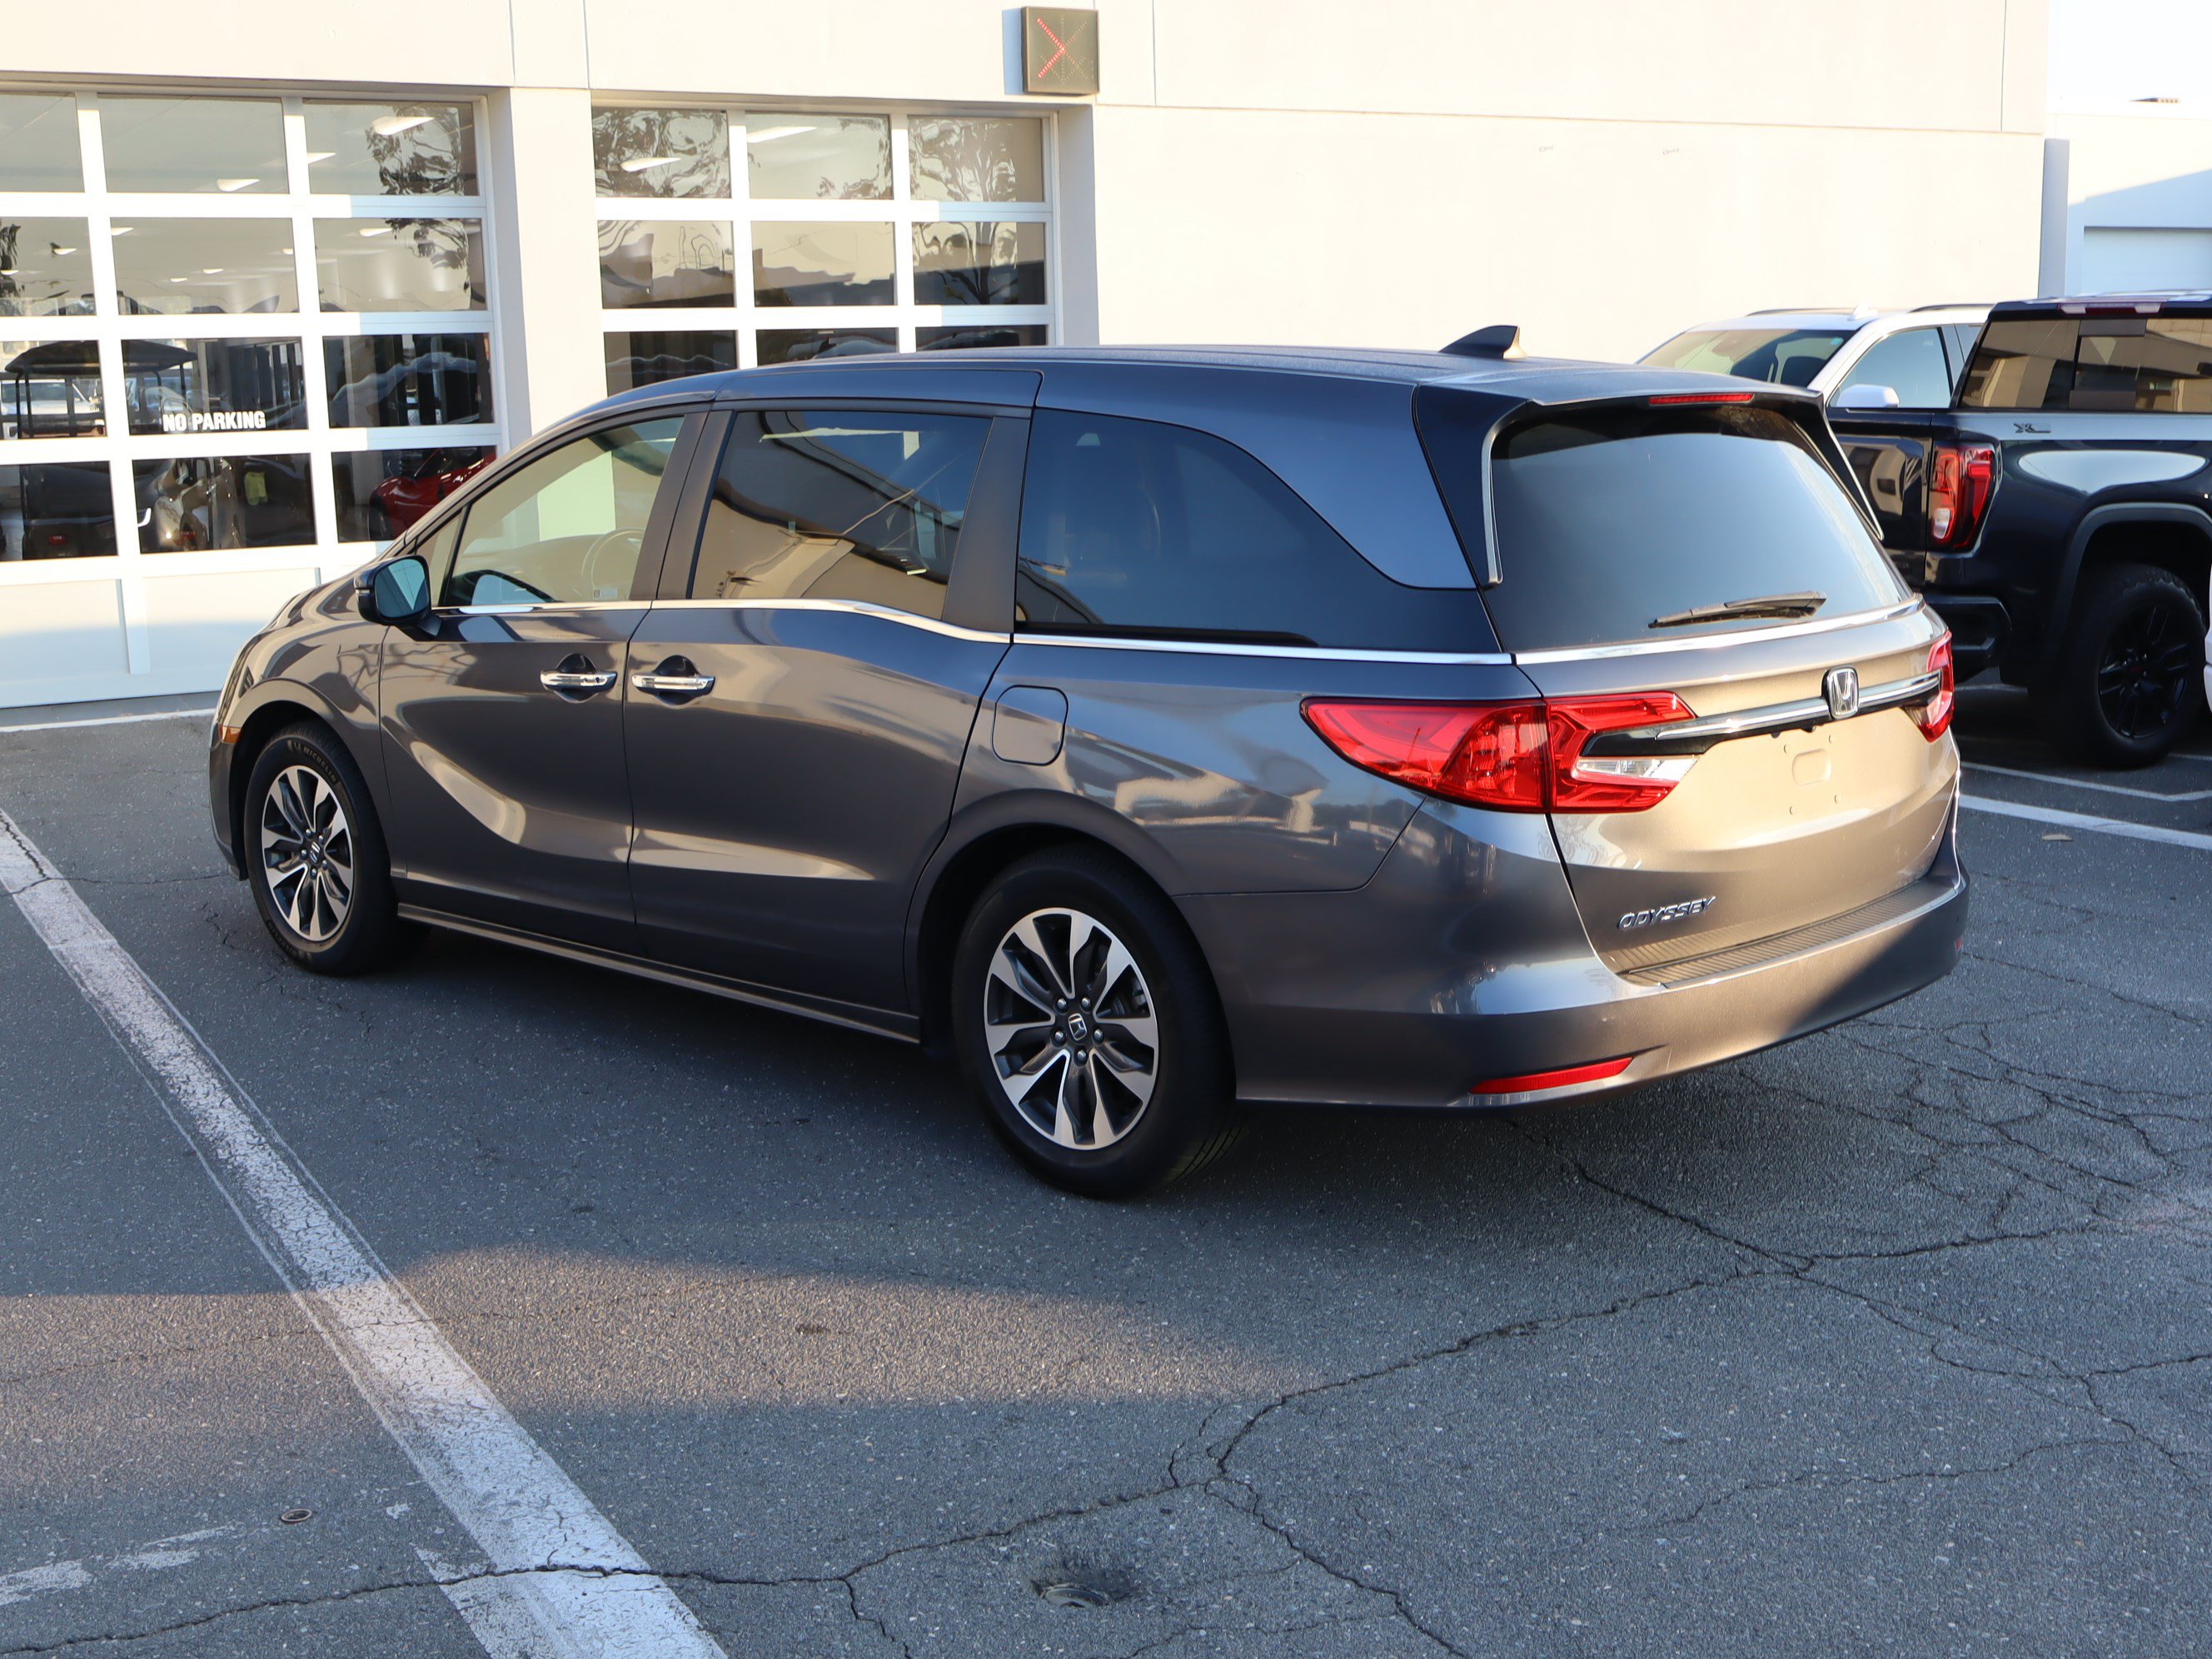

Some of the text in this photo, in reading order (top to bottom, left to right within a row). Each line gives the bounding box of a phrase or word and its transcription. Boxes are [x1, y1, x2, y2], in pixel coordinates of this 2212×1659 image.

[163, 411, 267, 431] NO PARKING
[1617, 895, 1716, 930] ODYSSEY
